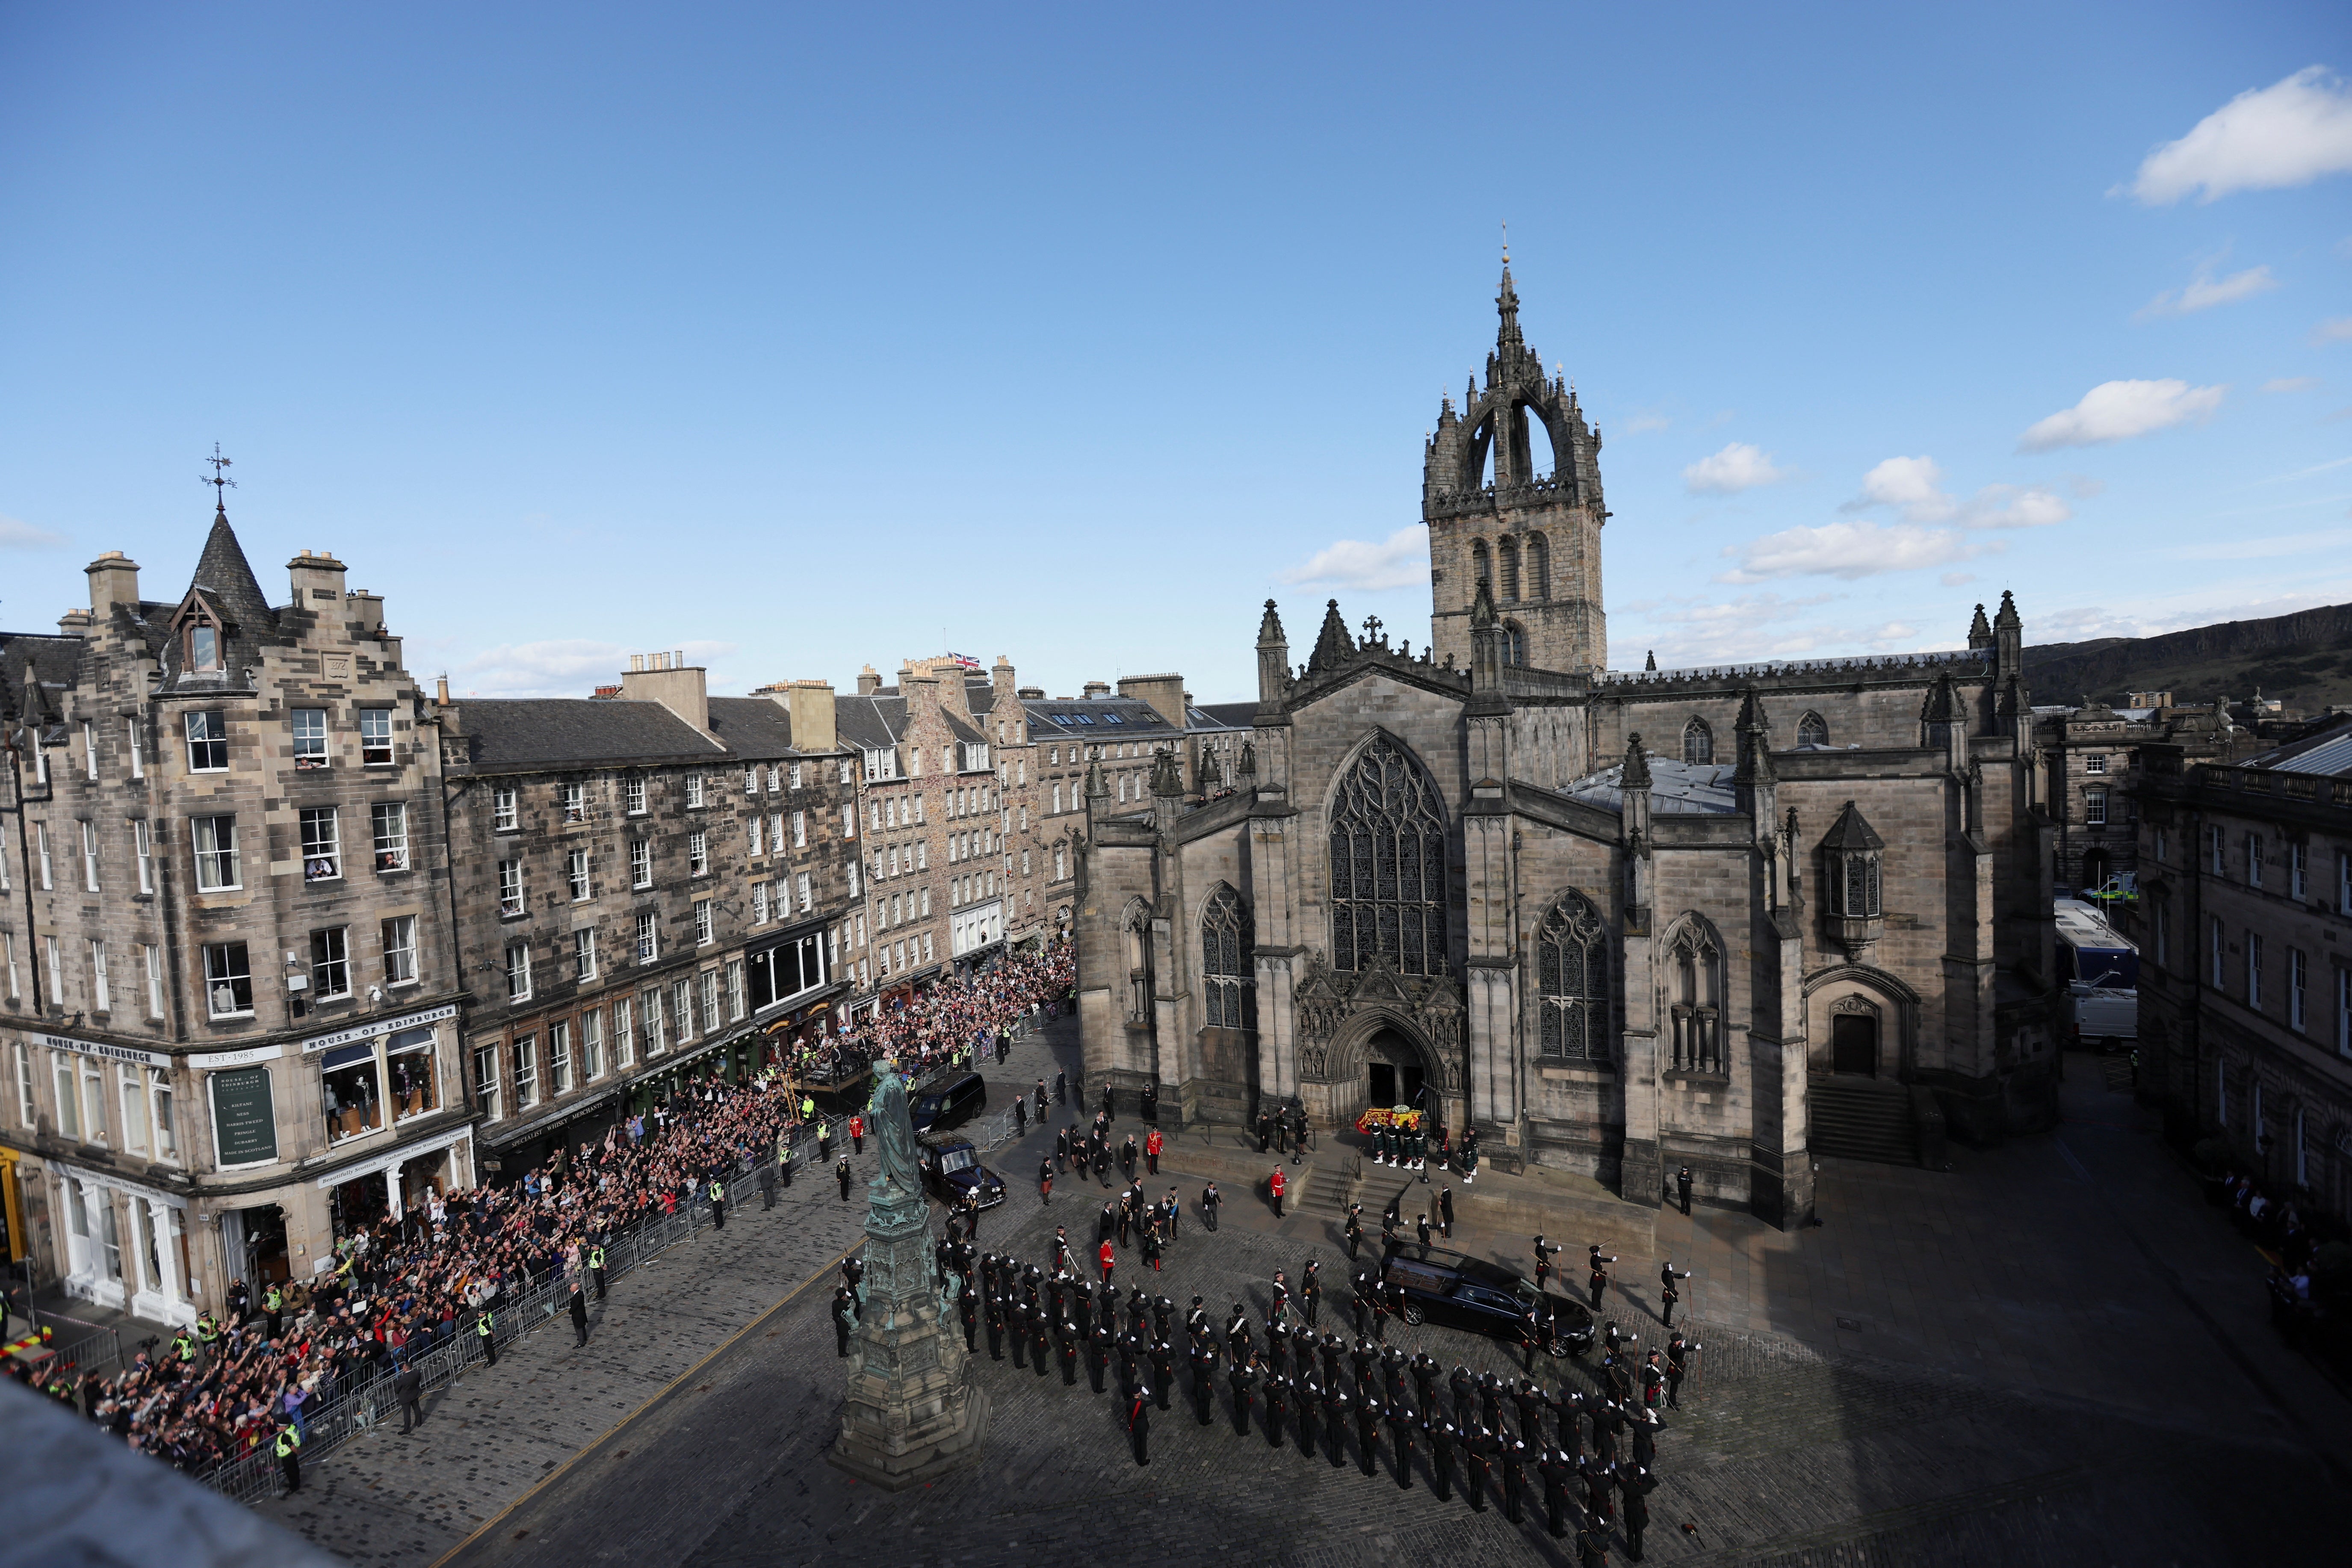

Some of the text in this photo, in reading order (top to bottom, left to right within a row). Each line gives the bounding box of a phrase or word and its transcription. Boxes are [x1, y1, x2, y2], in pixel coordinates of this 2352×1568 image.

[309, 1008, 453, 1049] HOUSE OF EDINBURGH
[47, 1037, 152, 1063] HOUSE OF EDINBURGH
[208, 1051, 254, 1063] EST 1985
[221, 1079, 260, 1087] EDINBURGH
[511, 1102, 603, 1148] SPECIALIST WHISKY MERCHANTS
[305, 1151, 337, 1166] HIGH STREET
[322, 1168, 354, 1184] Beautifully
[355, 1161, 377, 1172] Scottish
[423, 1139, 444, 1149] Woollens
[449, 1130, 466, 1139] Tweeds
[70, 1167, 87, 1178] Beautifully
[87, 1171, 101, 1180] Scottish
[130, 1184, 145, 1193] Woollens
